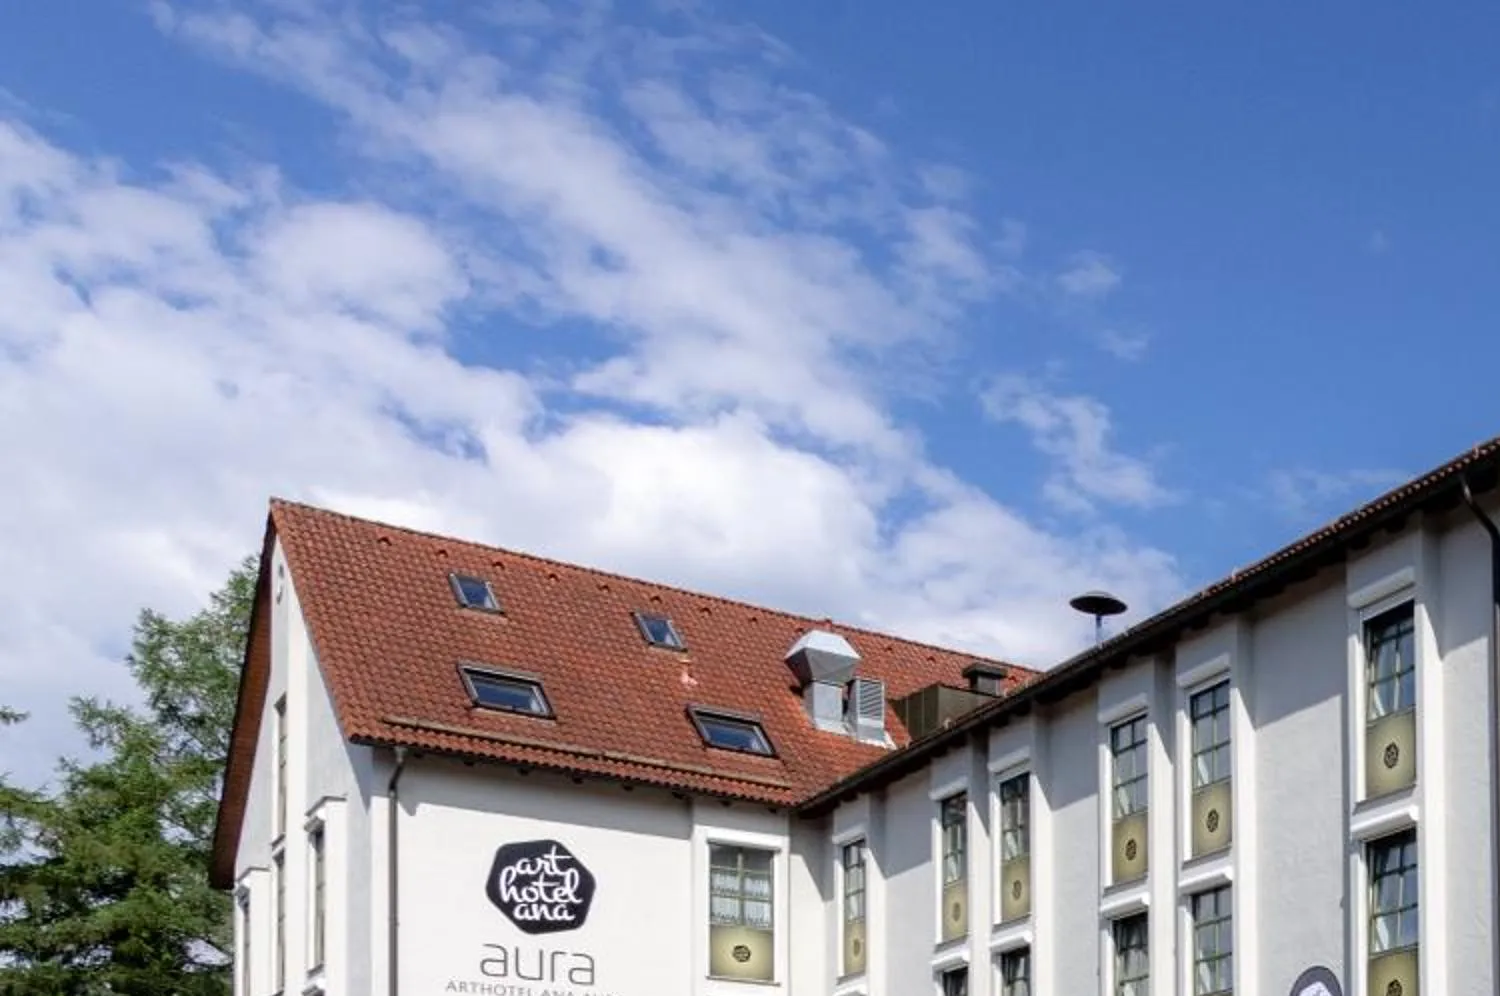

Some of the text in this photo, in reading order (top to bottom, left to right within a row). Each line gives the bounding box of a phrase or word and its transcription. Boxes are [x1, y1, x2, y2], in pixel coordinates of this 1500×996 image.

[515, 845, 574, 876] art
[499, 866, 584, 904] hotel
[513, 903, 577, 921] ana
[480, 943, 595, 986] aura
